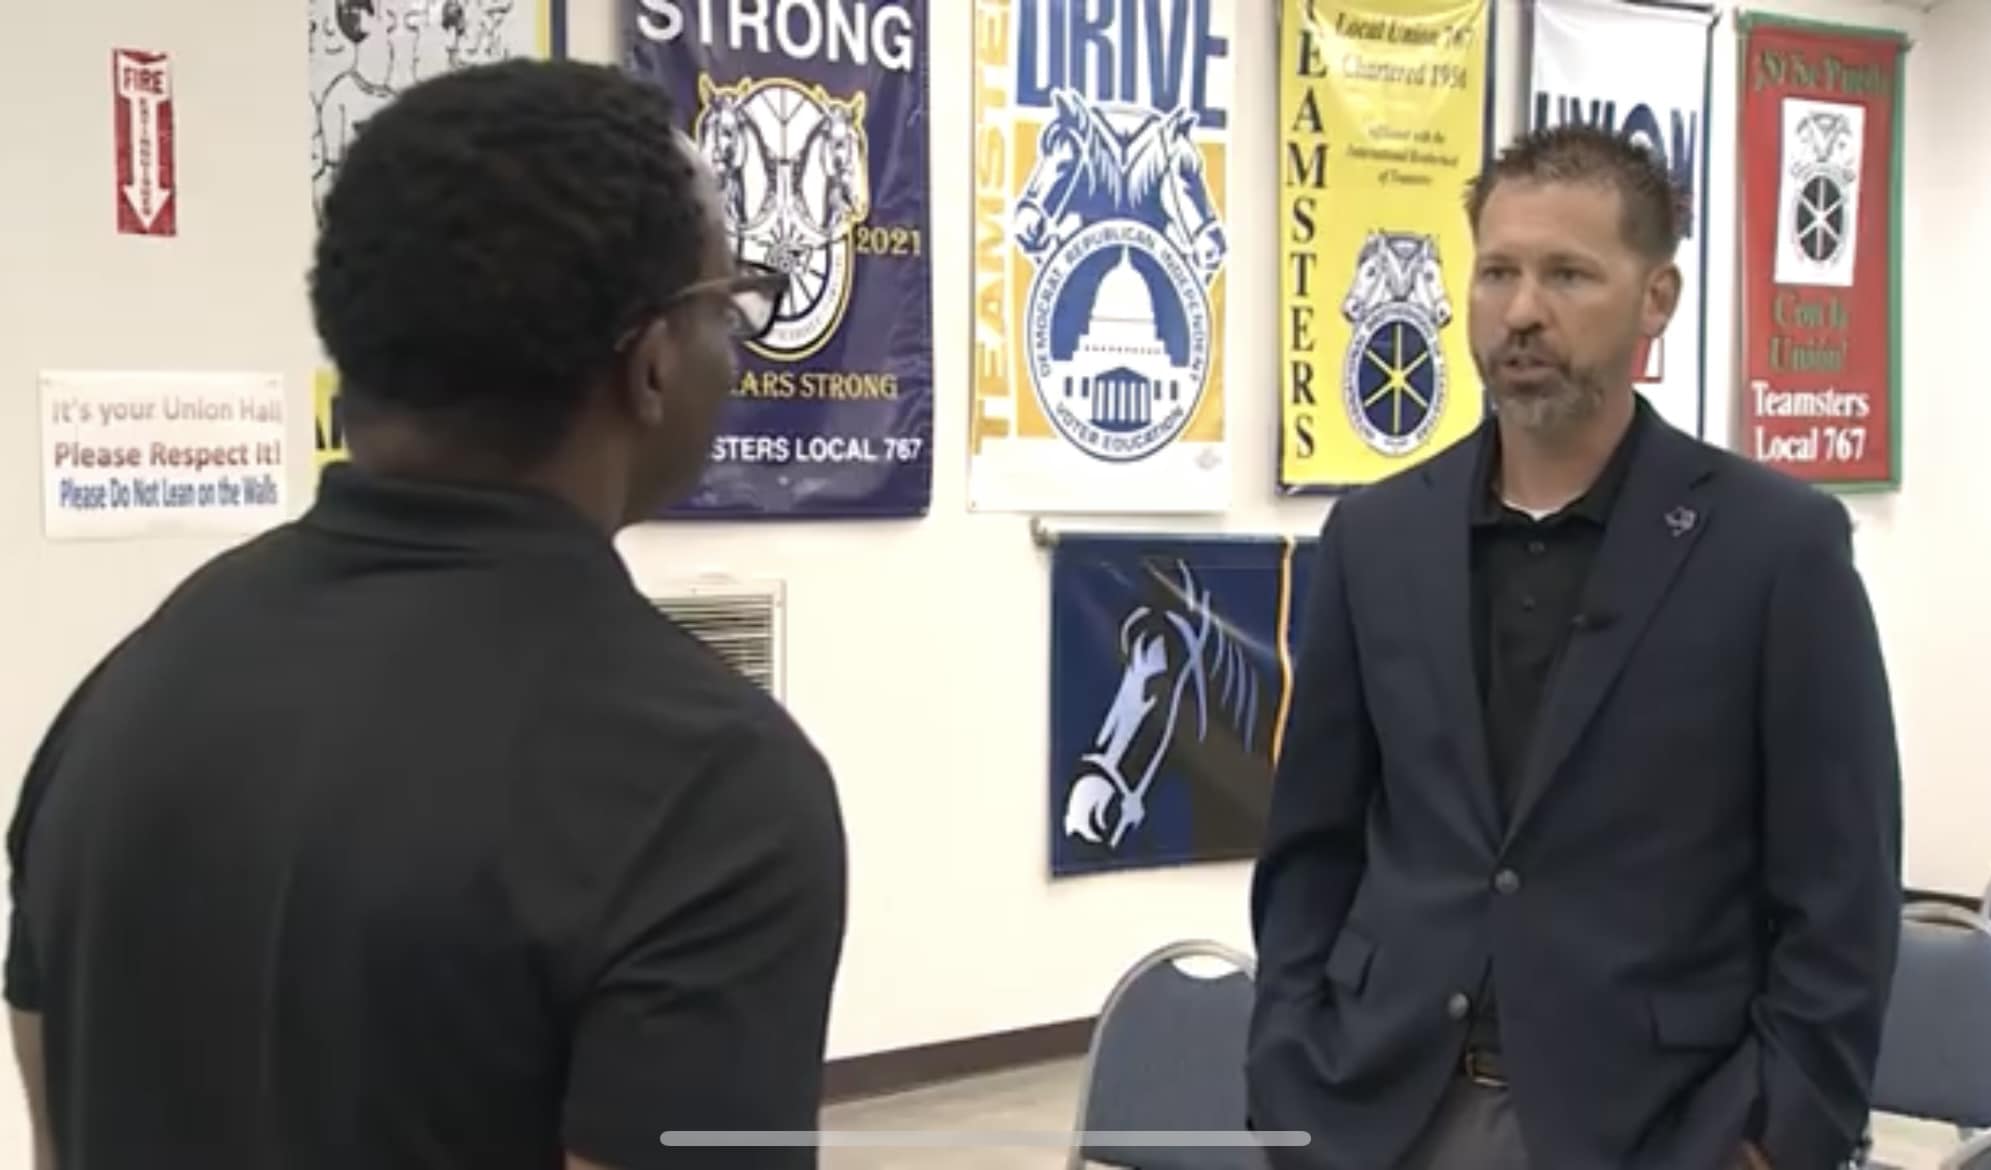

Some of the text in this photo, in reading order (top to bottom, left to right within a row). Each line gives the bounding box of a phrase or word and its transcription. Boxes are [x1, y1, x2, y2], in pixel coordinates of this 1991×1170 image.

[636, 0, 914, 71] STRONG
[123, 67, 164, 94] FIRE
[1016, 0, 1228, 130] DRIVE
[857, 226, 921, 255] 2021
[974, 0, 1009, 455] TEAMSTE
[1035, 268, 1063, 378] DEMOCRAT
[1065, 226, 1156, 262] REPUBLICAN
[734, 372, 898, 398] ARS STRONG
[1751, 380, 1870, 418] Teamsters
[52, 397, 92, 424] It's
[99, 401, 155, 426] your
[163, 396, 233, 421] Union
[1056, 402, 1184, 451] VOTER EDUCATION
[54, 441, 140, 468] Please
[149, 441, 249, 471] Respect
[713, 436, 923, 462] STERS LOCAL 767
[1755, 426, 1867, 462] Local 767
[60, 475, 278, 508] Please Do Not Lean on the Walls
